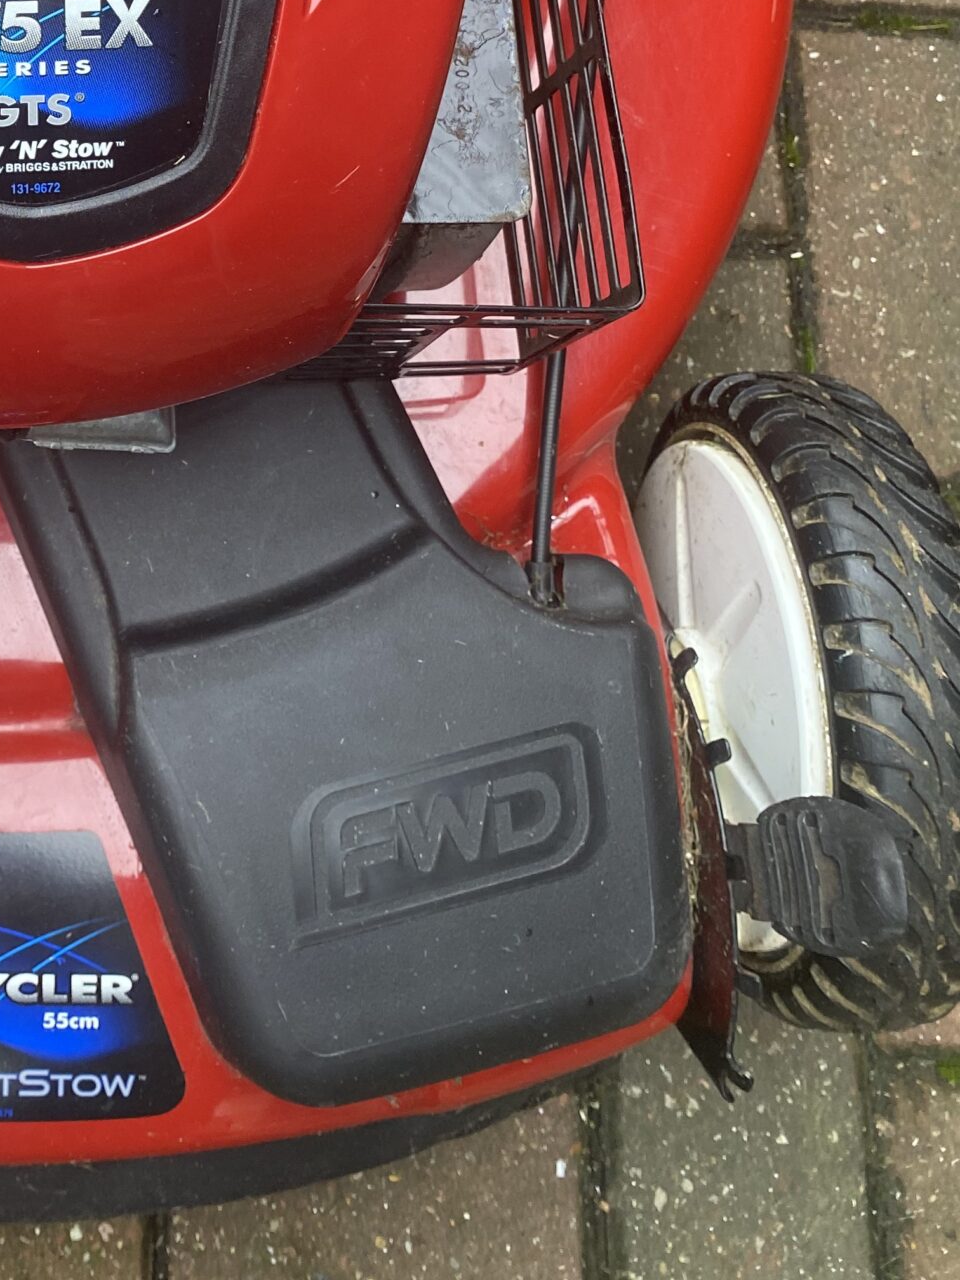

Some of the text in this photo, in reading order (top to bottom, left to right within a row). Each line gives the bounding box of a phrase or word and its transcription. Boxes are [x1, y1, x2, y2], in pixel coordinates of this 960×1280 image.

[5, 158, 115, 174] BRIGGS&STRATTON
[10, 182, 62, 196] 131-9672
[340, 770, 562, 899] FWD
[42, 1011, 100, 1031] 55cm
